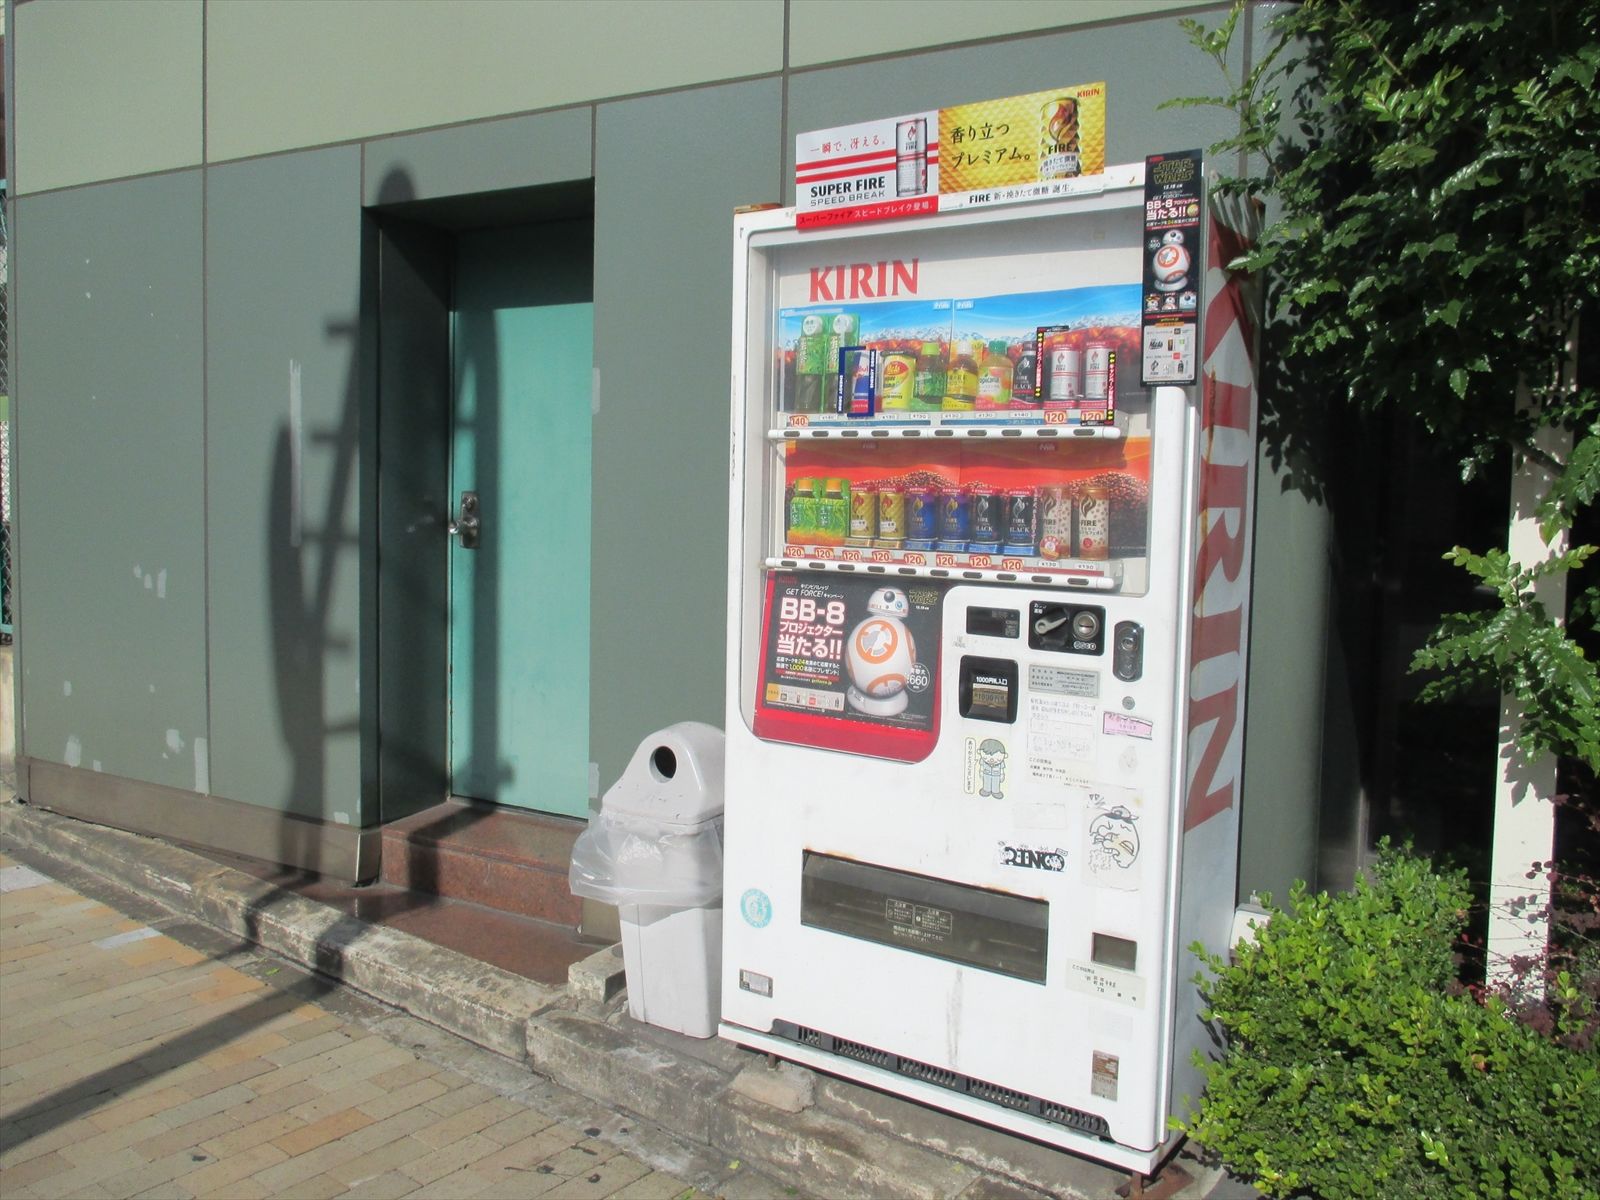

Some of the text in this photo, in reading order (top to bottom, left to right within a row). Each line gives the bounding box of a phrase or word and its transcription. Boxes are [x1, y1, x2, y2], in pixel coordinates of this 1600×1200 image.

[1076, 88, 1100, 98] KIRIN
[950, 122, 1010, 144] 香り立つ
[1048, 143, 1073, 155] FIRE
[951, 147, 1031, 169] プレミアム。
[810, 176, 886, 198] SUPER FIRE
[810, 190, 885, 207] SPEED BREAK
[969, 193, 991, 204] FIRE
[1146, 198, 1173, 210] BB-8
[808, 257, 919, 303] KIRIN
[1047, 412, 1065, 422] 120
[1082, 411, 1102, 421] 120
[791, 418, 805, 427] 140
[1080, 519, 1097, 527] FIRE
[787, 548, 802, 557] 120
[816, 549, 831, 558] 120
[843, 552, 860, 561] 120
[873, 552, 890, 562] 120
[904, 554, 922, 565] 120
[936, 556, 954, 566] 120
[970, 557, 988, 567] 120
[1003, 561, 1022, 571] 120
[801, 590, 825, 598] FORCE!
[780, 597, 845, 625] BB-8
[779, 621, 843, 638] プロジェクター
[776, 634, 842, 661] 当たる!!
[909, 674, 928, 686] 660
